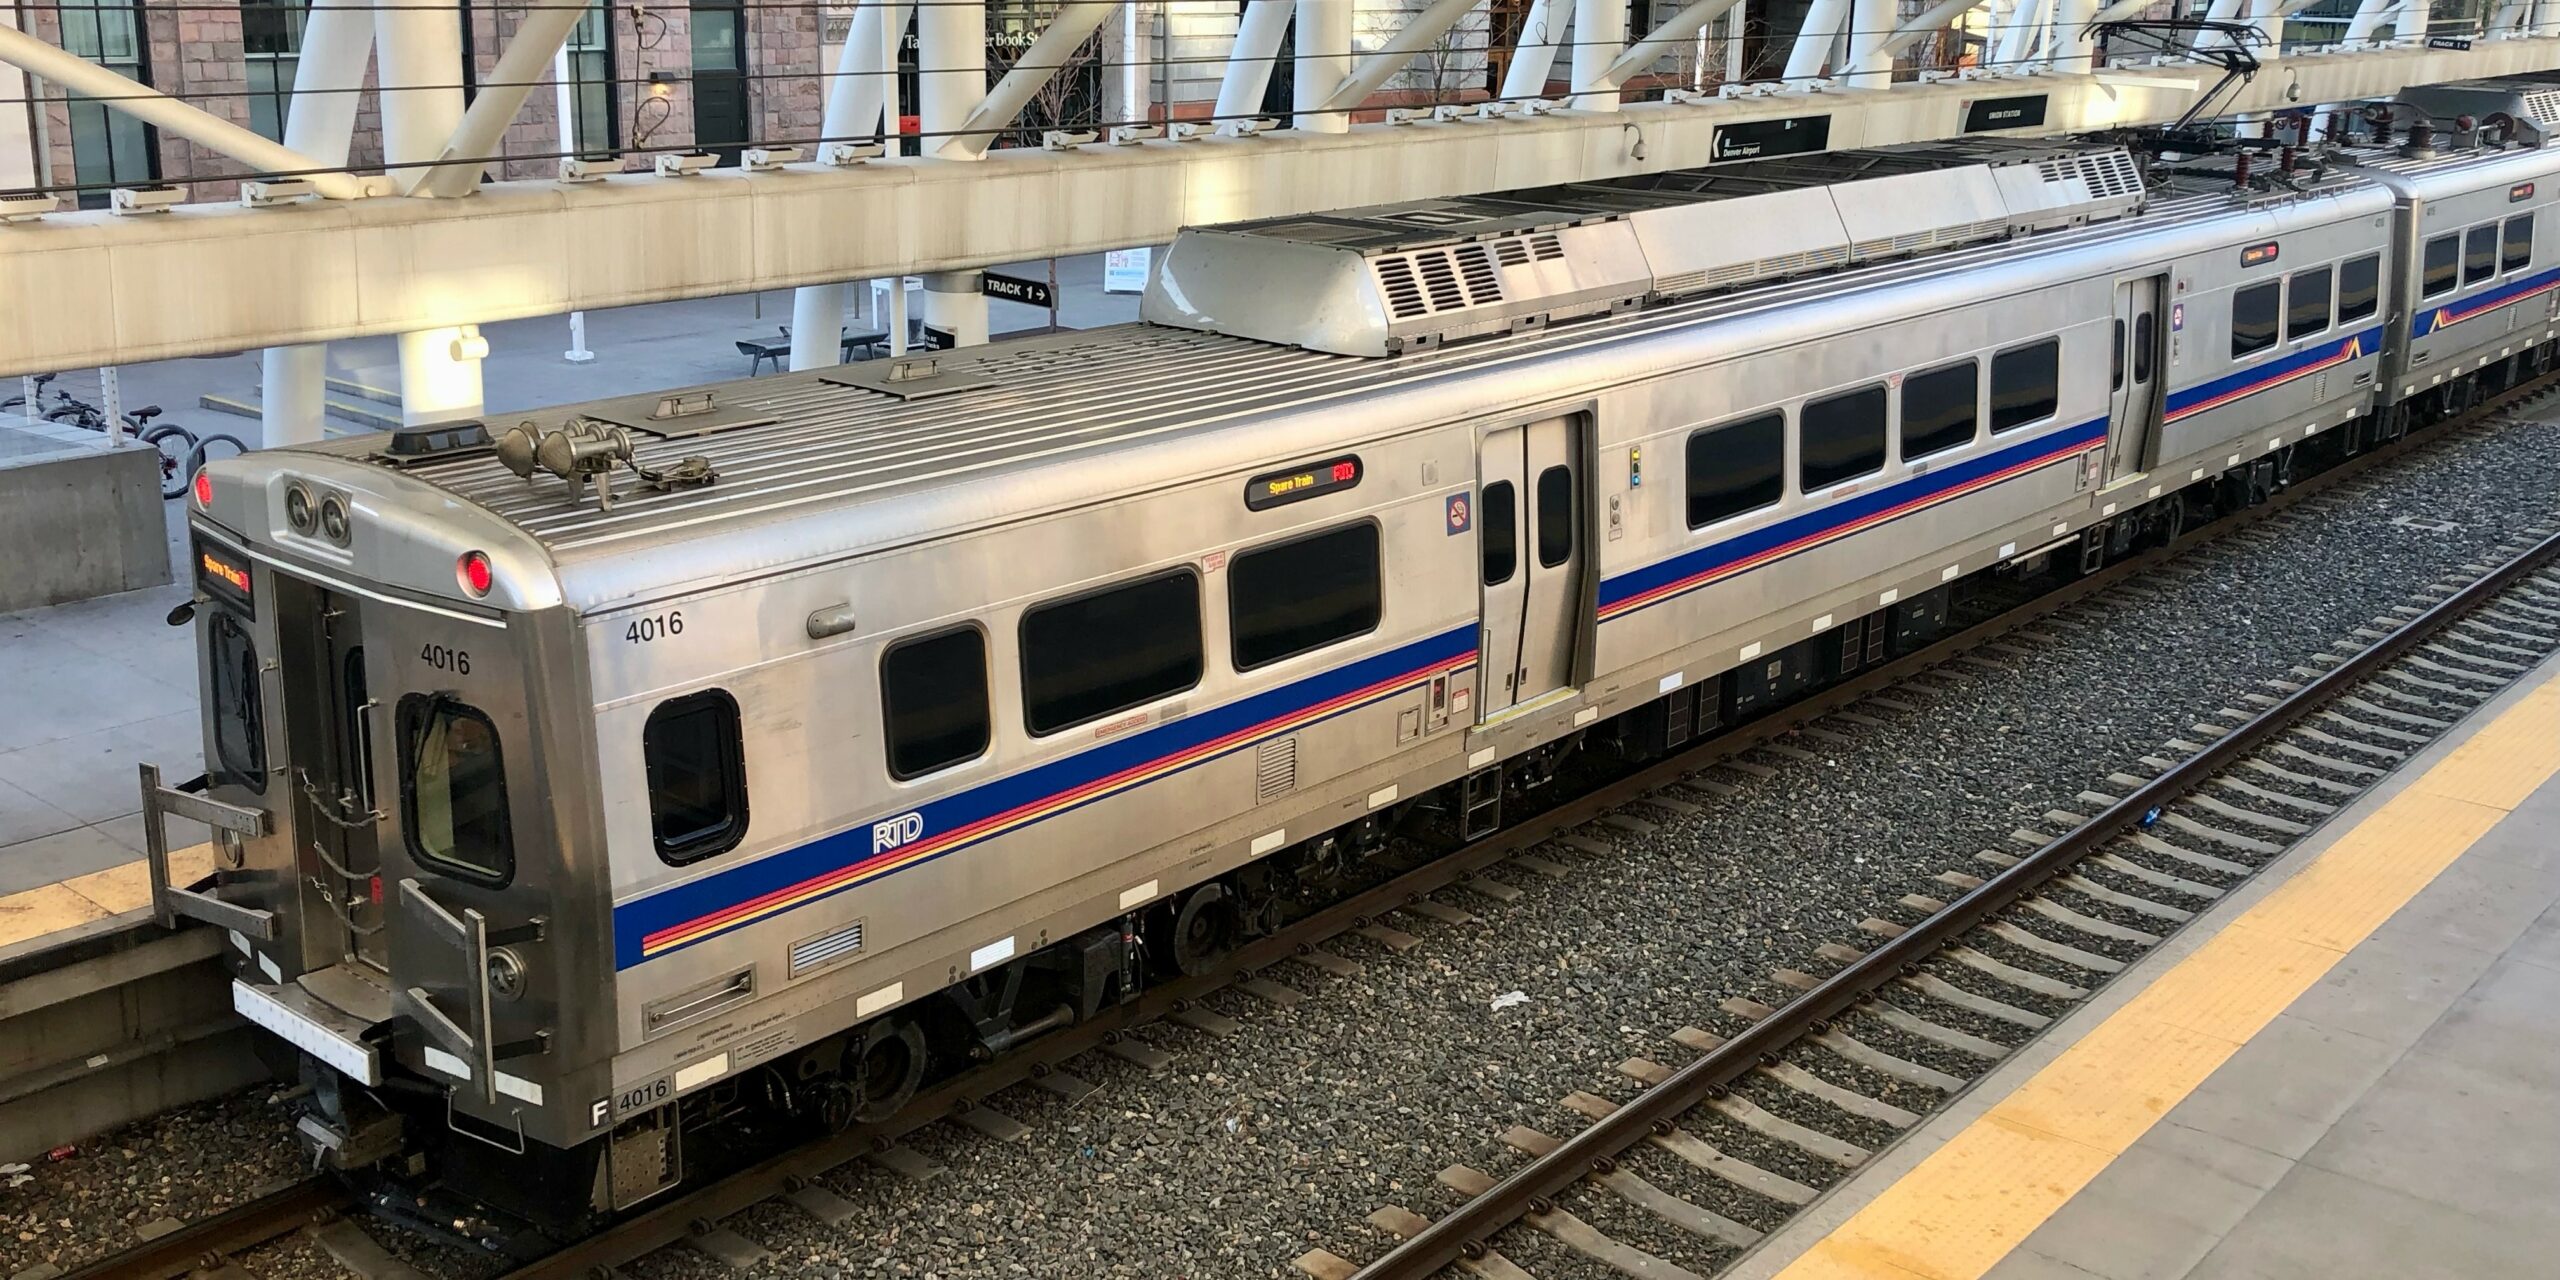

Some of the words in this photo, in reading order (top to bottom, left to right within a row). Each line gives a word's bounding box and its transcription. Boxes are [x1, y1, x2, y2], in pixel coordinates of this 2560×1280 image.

[996, 33, 1024, 47] Book
[1723, 148, 1741, 157] Denver
[1742, 146, 1760, 156] Airport
[987, 279, 1022, 296] TRACK
[1026, 286, 1033, 300] 1
[1269, 481, 1293, 495] Spare
[1295, 474, 1314, 488] Train
[626, 610, 684, 644] 4016
[421, 643, 471, 675] 4016
[873, 811, 924, 855] RTD
[592, 1099, 609, 1127] F
[620, 1079, 667, 1110] 4016
